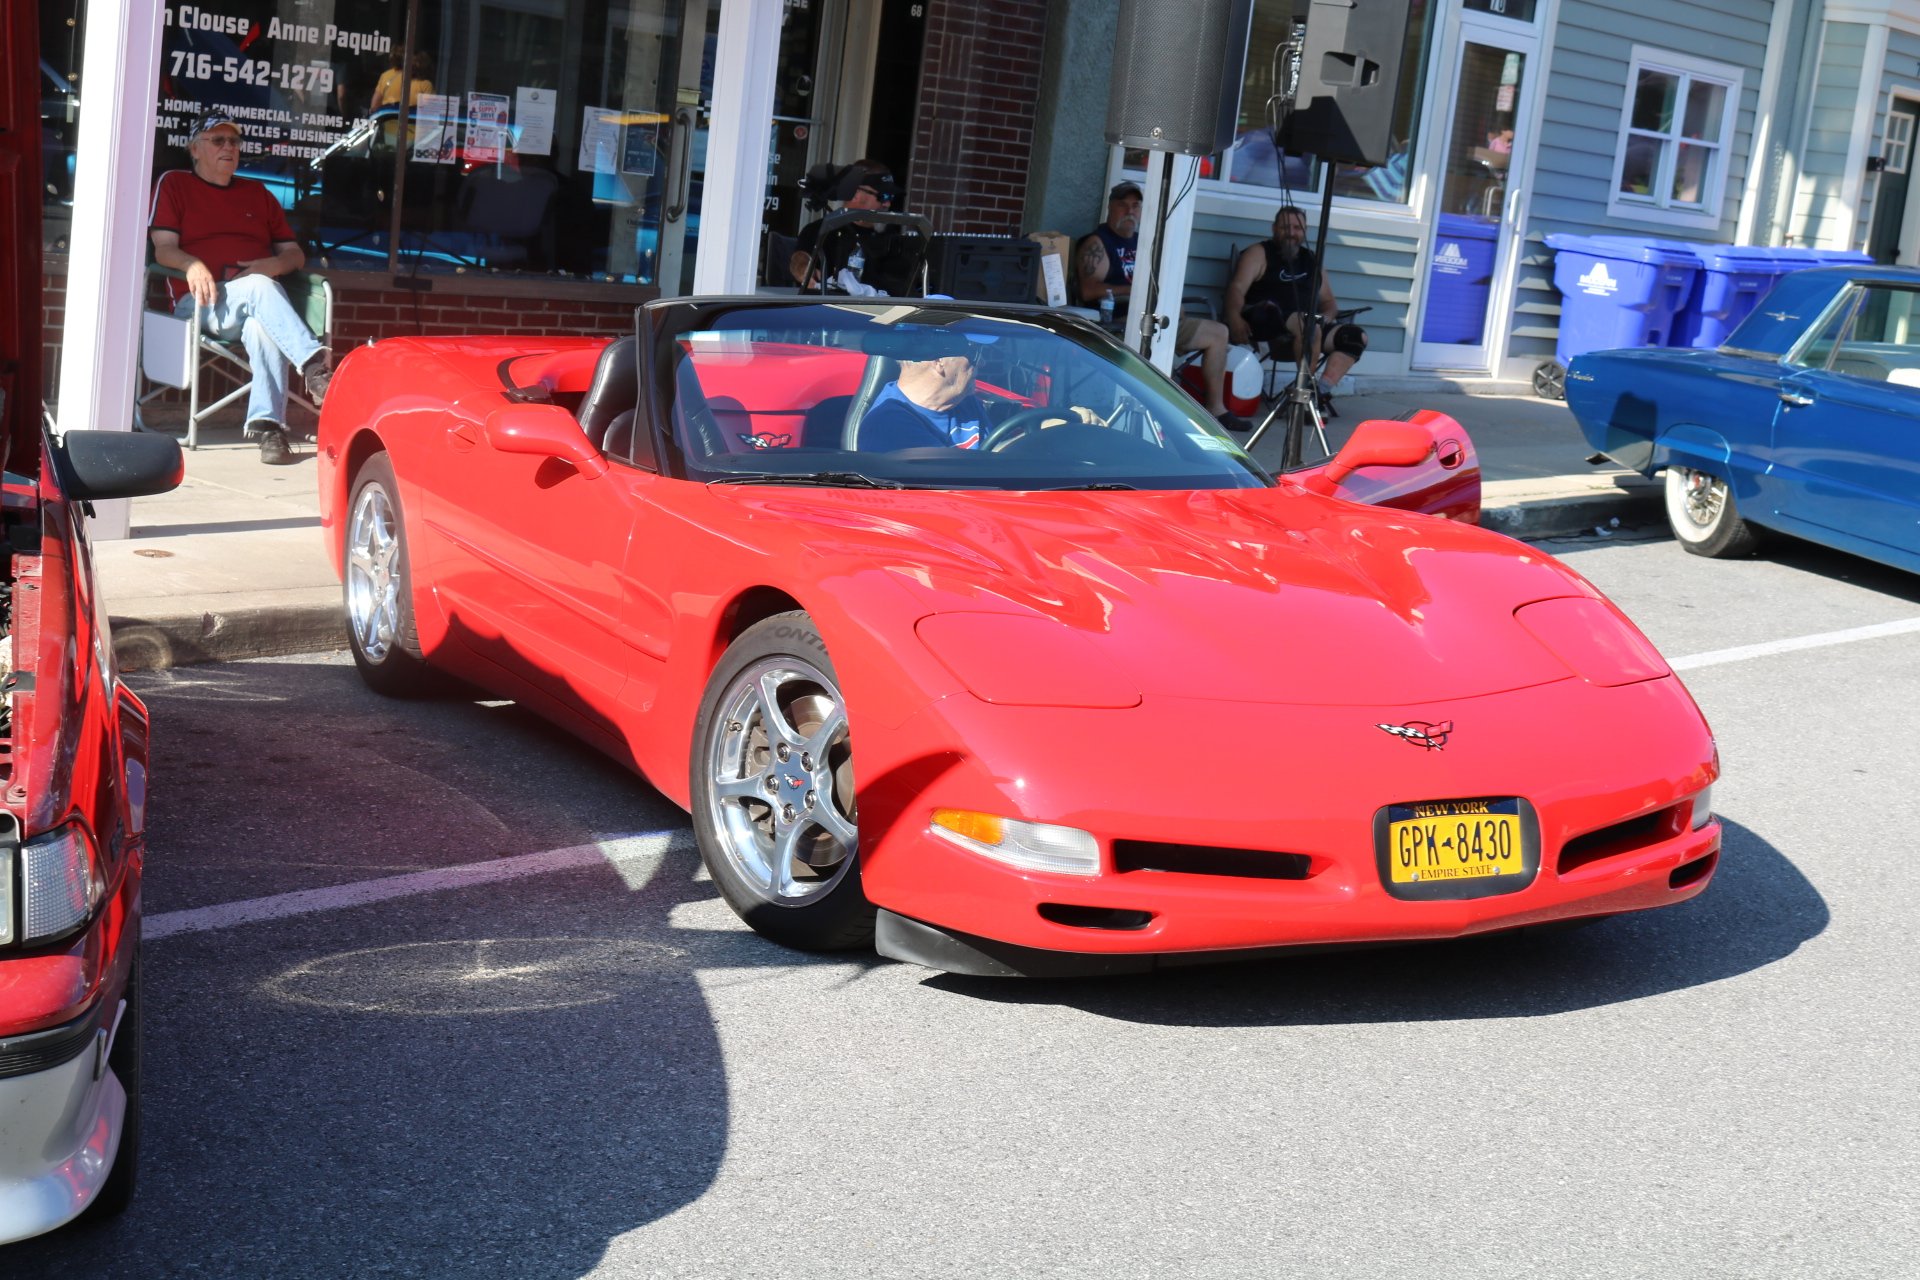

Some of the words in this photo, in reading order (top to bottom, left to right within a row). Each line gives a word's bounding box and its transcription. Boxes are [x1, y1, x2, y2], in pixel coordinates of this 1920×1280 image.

[179, 5, 249, 35] Clouse
[911, 5, 922, 17] 68
[267, 17, 319, 43] Anne
[324, 24, 391, 55] Paquin
[171, 51, 334, 93] 716-542-1279
[164, 99, 201, 115] HOME
[302, 113, 343, 127] FARMS
[1414, 804, 1449, 818] NEW
[1451, 801, 1489, 814] YORK
[1399, 825, 1440, 867] GPK
[1457, 819, 1511, 863] 8430
[1421, 868, 1460, 880] EMPIRE
[1463, 864, 1493, 876] STATE
